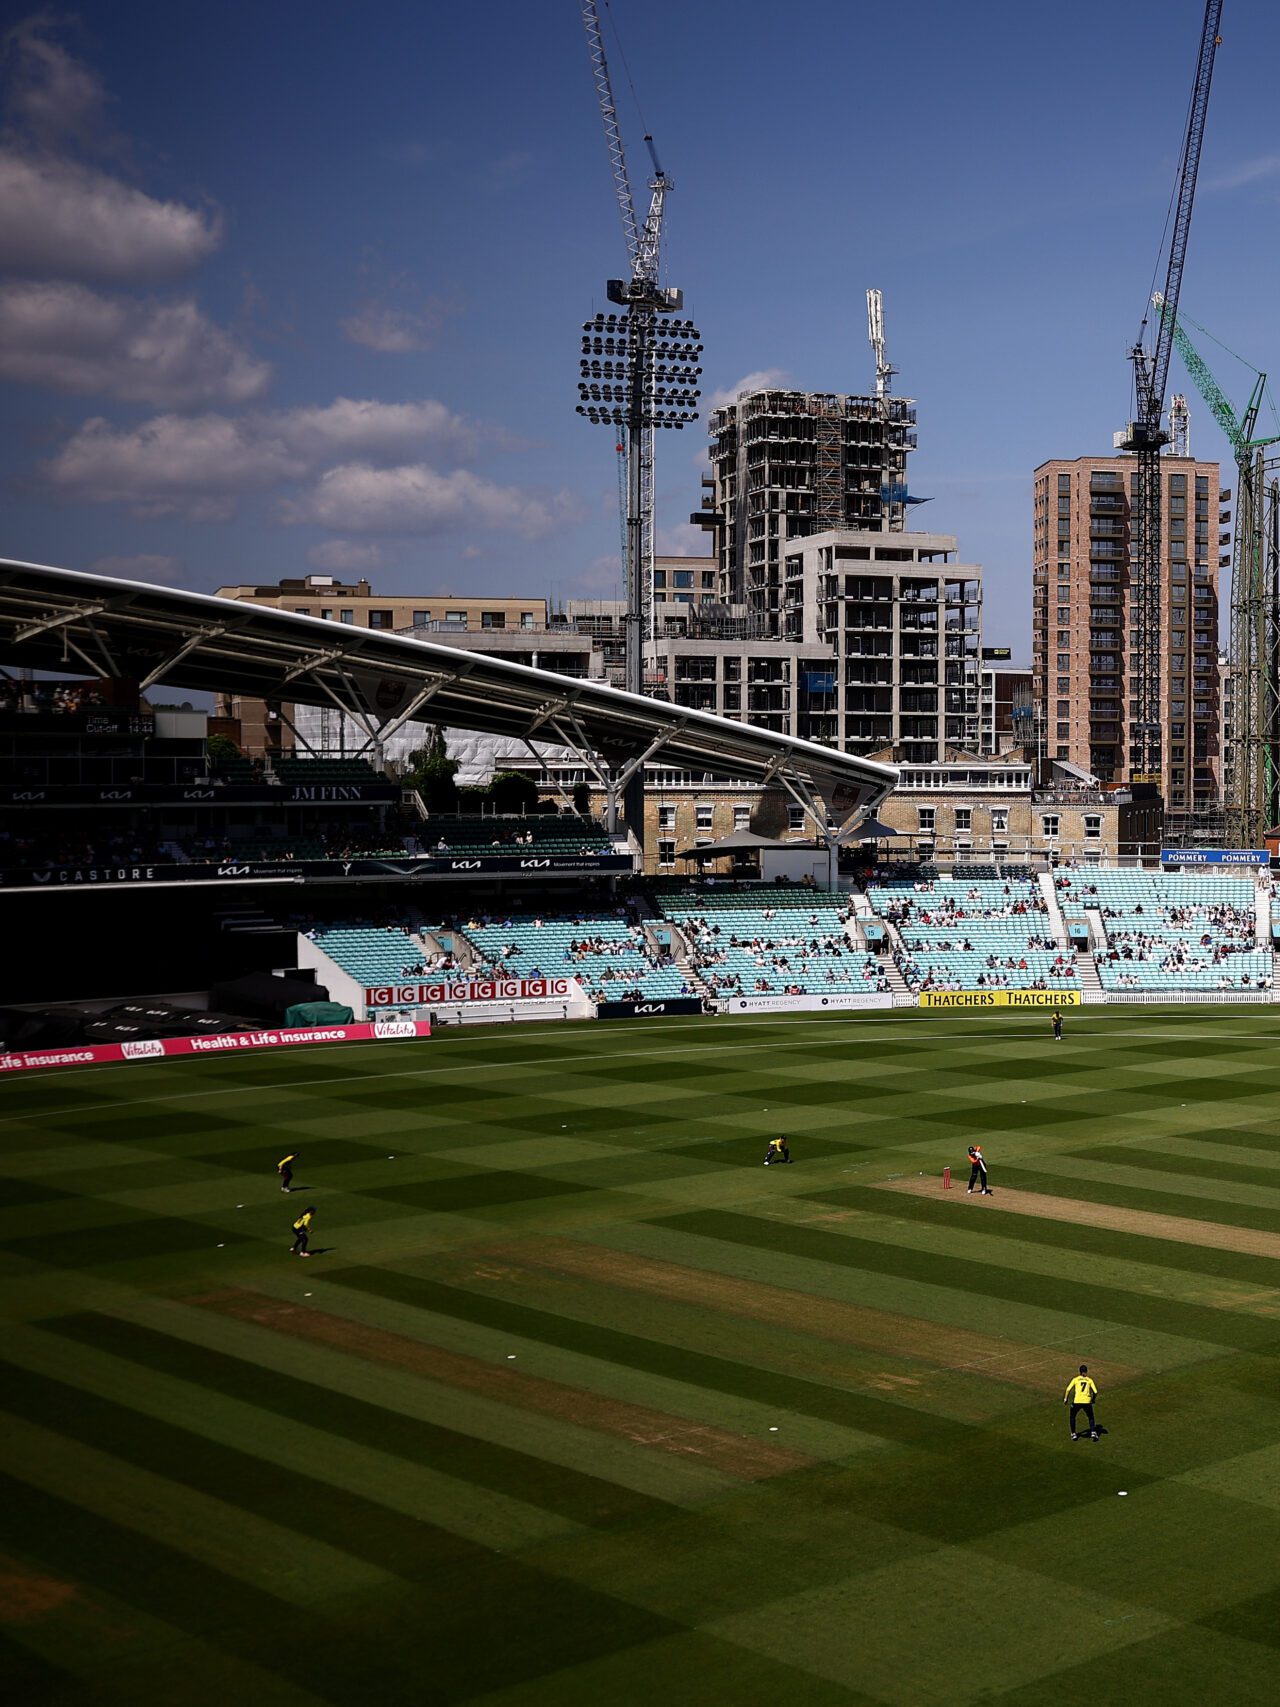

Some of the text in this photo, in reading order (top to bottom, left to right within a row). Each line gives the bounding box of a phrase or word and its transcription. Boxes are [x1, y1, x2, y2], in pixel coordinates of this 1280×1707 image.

[86, 724, 119, 733] Cut-off
[291, 786, 362, 800] JM FINN
[452, 860, 482, 869] KIA
[520, 859, 550, 868] KIA
[1168, 854, 1207, 862] POMMERY
[59, 868, 155, 882] CASTORE
[217, 865, 250, 876] KIA
[423, 985, 441, 1001] IG
[449, 984, 466, 999] IG
[474, 982, 492, 998] IG
[500, 981, 517, 997] IG
[525, 980, 543, 996] IG
[551, 979, 568, 994] IG
[370, 988, 389, 1004] IG
[397, 987, 415, 1003] IG
[926, 992, 995, 1006] THATCHERS
[1006, 992, 1074, 1005] THATCHERS
[634, 1003, 665, 1013] KIA
[376, 1023, 416, 1037] Vitality
[190, 1029, 346, 1050] Health & Life insurance
[123, 1041, 163, 1057] Vitality
[23, 1051, 95, 1067] insurance
[1080, 1381, 1088, 1393] 7
